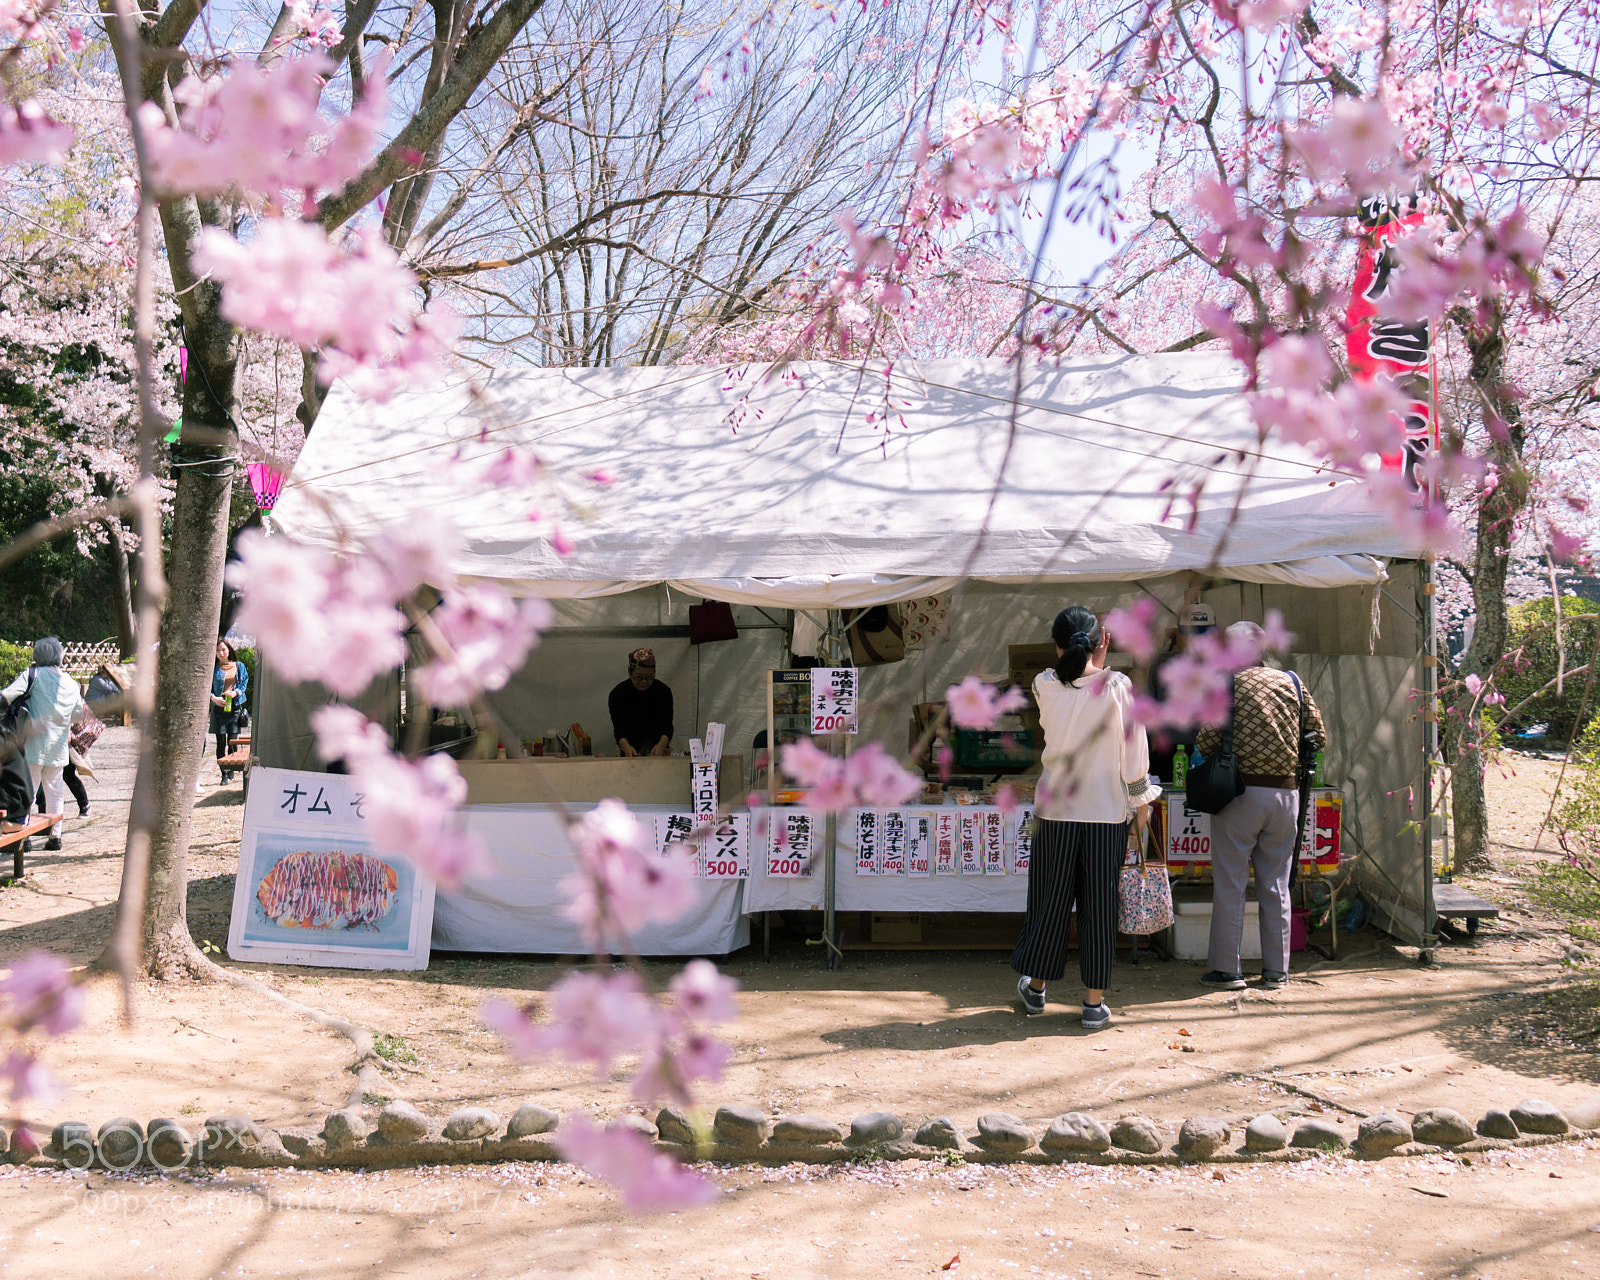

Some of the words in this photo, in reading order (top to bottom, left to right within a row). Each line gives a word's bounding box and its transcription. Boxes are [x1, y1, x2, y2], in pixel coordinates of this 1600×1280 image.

[799, 673, 811, 681] BO
[831, 670, 854, 715] 味噌おでん
[281, 783, 332, 815] オム
[698, 766, 713, 812] チュロス
[715, 814, 739, 857] オムソバ
[787, 815, 810, 859] 味噌おでん
[860, 812, 875, 860] 焼そば
[886, 812, 904, 860] 手羽元チキン
[938, 815, 952, 864] チキン唐揚げ
[962, 818, 974, 863] たこ焼き
[987, 813, 1000, 863] 焼きそば
[1171, 836, 1211, 854] ¥400
[707, 860, 747, 877] 500円
[1016, 860, 1029, 869] 40
